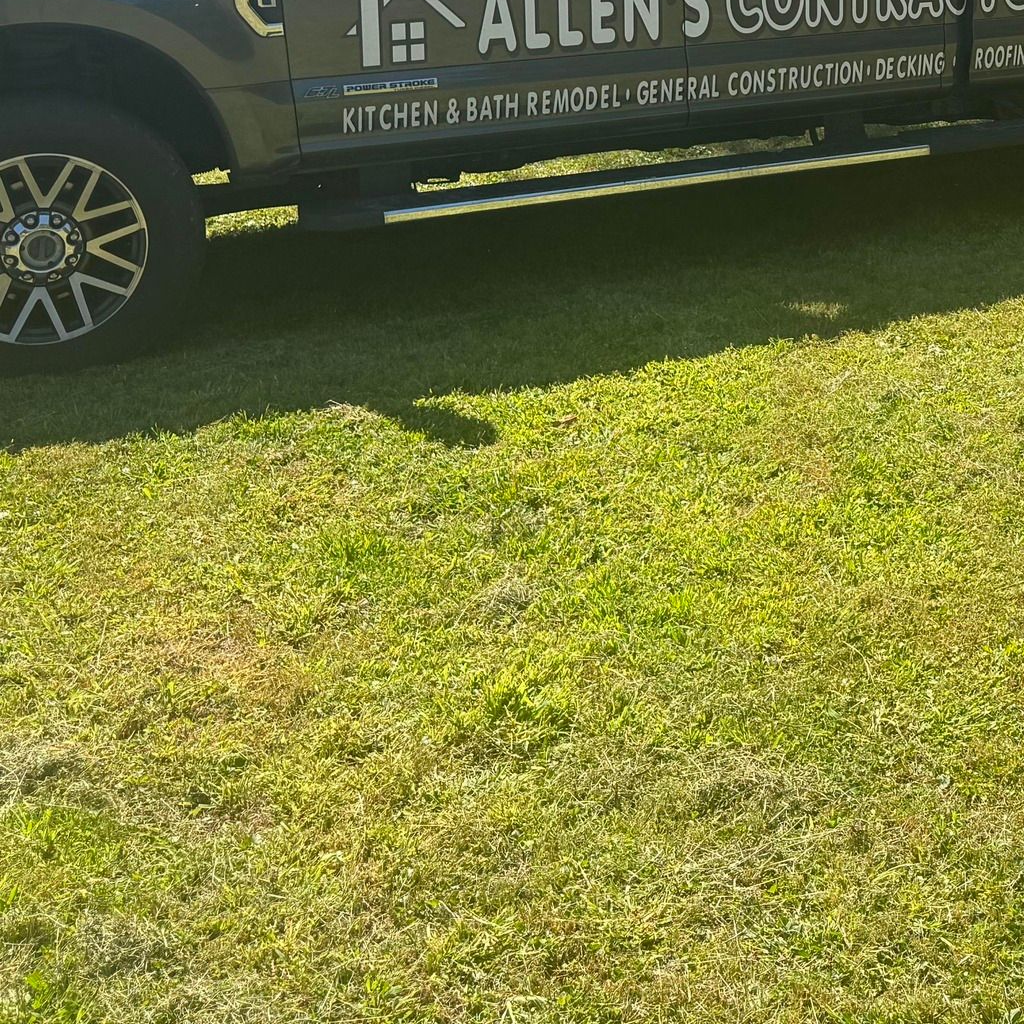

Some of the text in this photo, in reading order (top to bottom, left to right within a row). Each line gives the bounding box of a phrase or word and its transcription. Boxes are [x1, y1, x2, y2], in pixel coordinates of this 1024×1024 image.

[342, 99, 438, 134] KITCHEN
[446, 97, 460, 125] &
[466, 92, 519, 122] BATH
[527, 83, 621, 117] REMODEL
[636, 74, 720, 106] GENERAL
[727, 59, 863, 96] CONSTRUCTION
[875, 51, 945, 81] DECKING
[346, 83, 387, 93] POWER
[389, 78, 435, 89] STROKE
